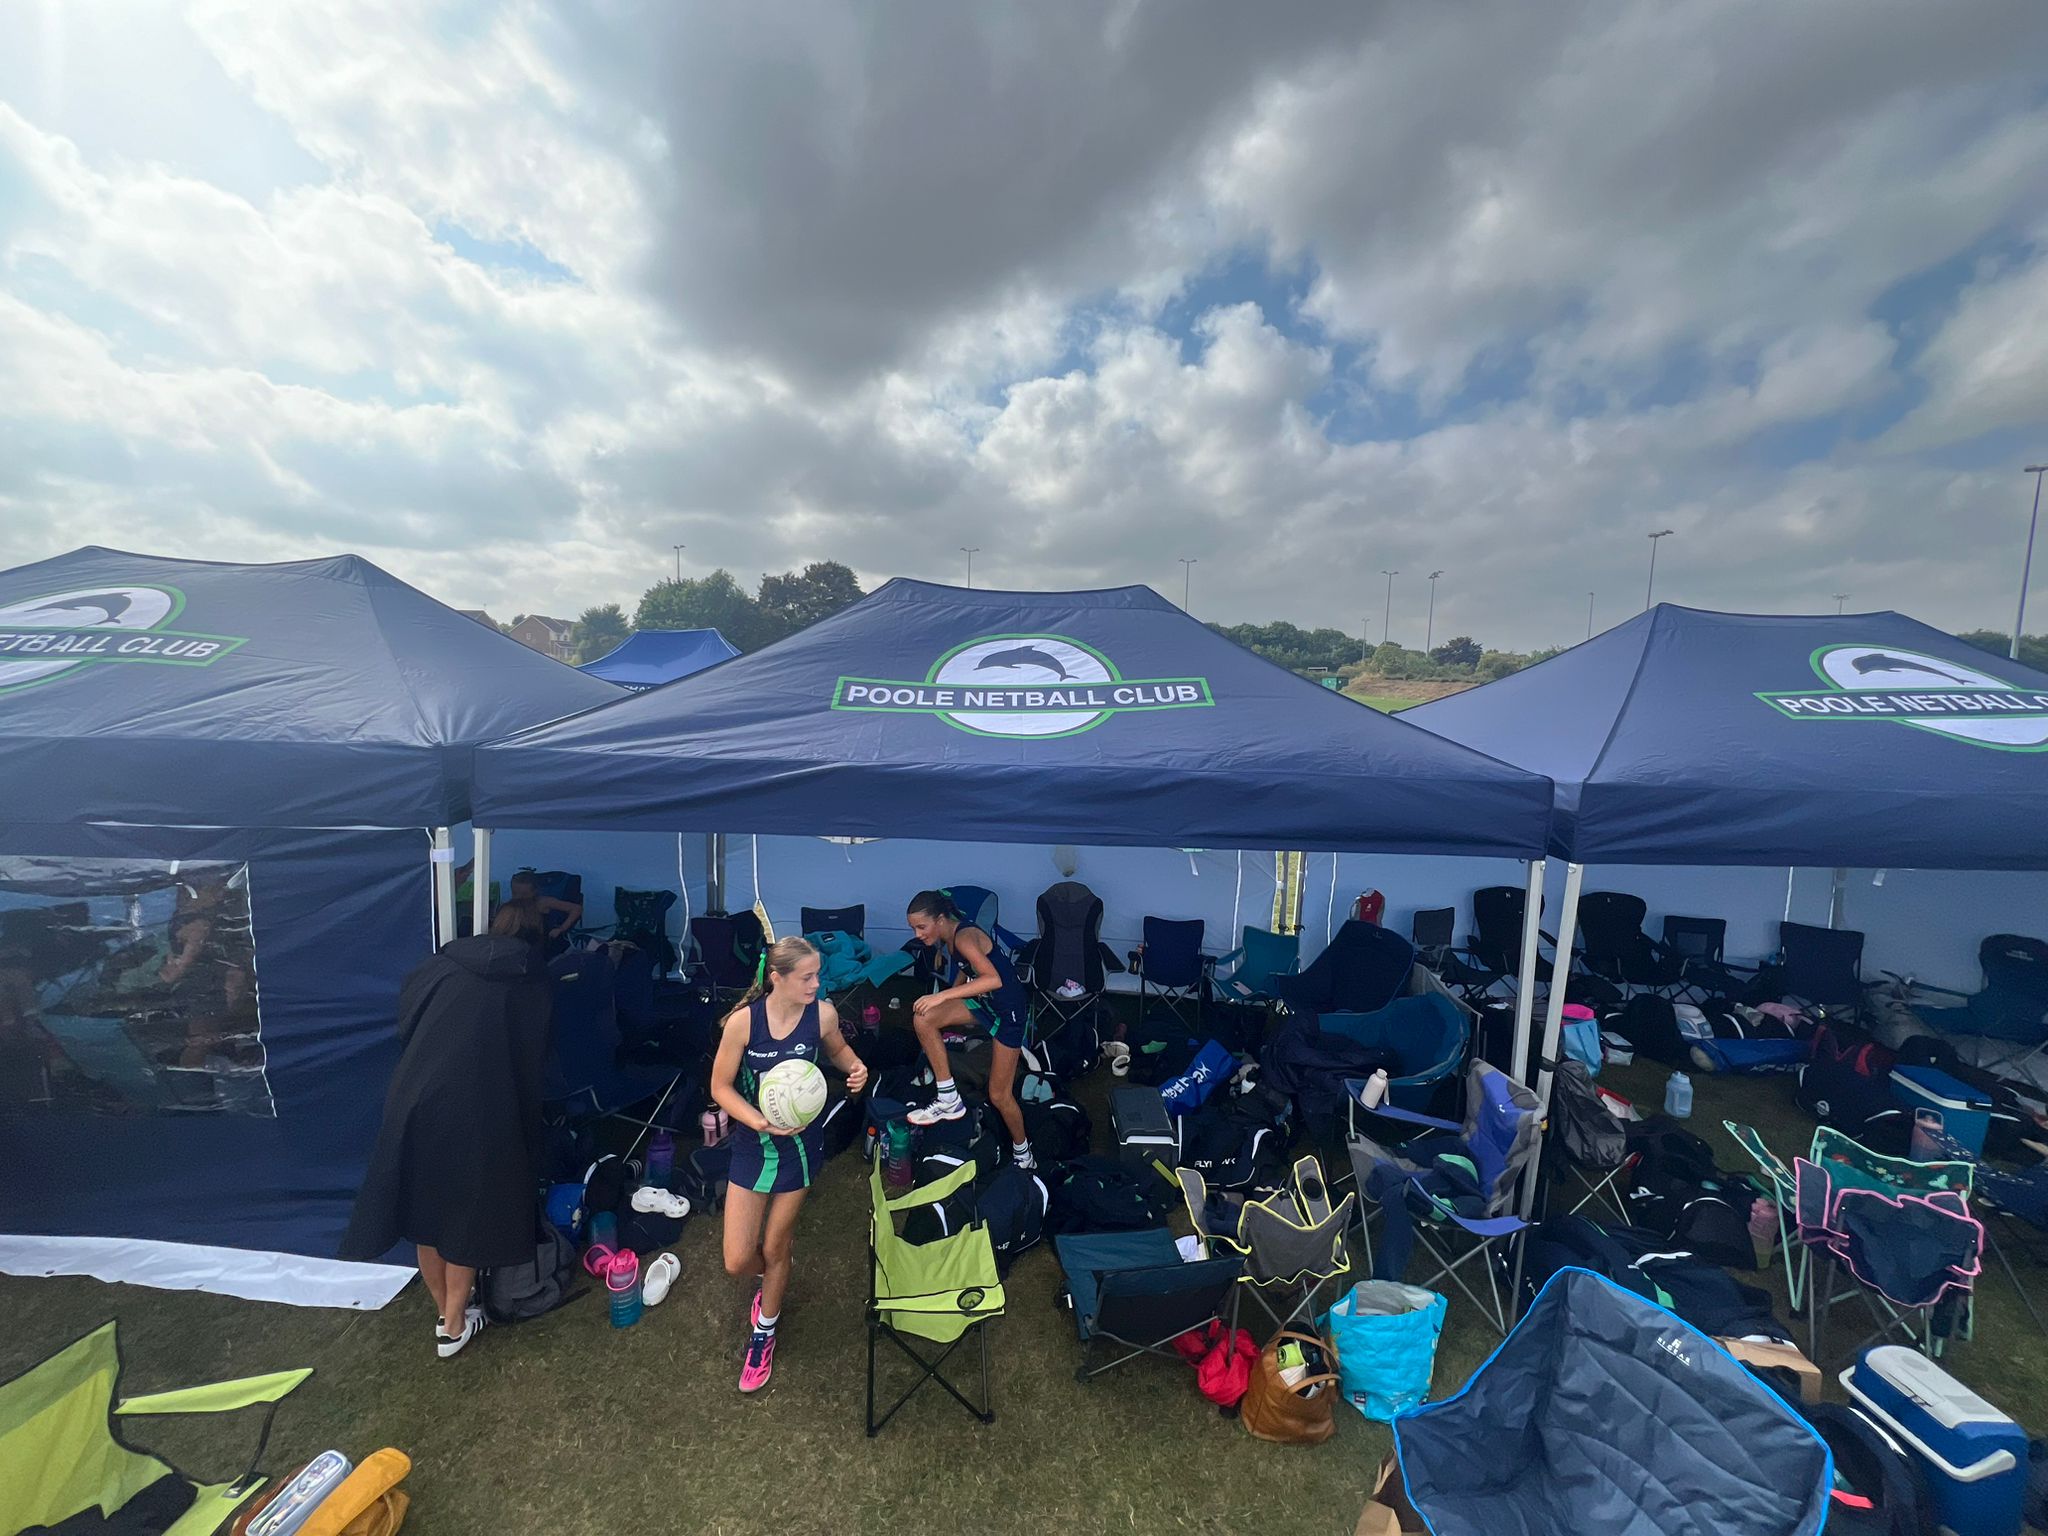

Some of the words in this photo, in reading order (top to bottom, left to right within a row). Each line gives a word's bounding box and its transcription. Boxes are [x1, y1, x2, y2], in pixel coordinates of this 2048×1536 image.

[118, 636, 220, 657] CLUB
[847, 685, 954, 707] POOLE
[965, 690, 1106, 707] NETBALL
[1113, 685, 1199, 704] CLUB
[1776, 696, 1896, 713] POOLE
[1892, 694, 2044, 712] NETBALL
[768, 1088, 789, 1127] GILBER
